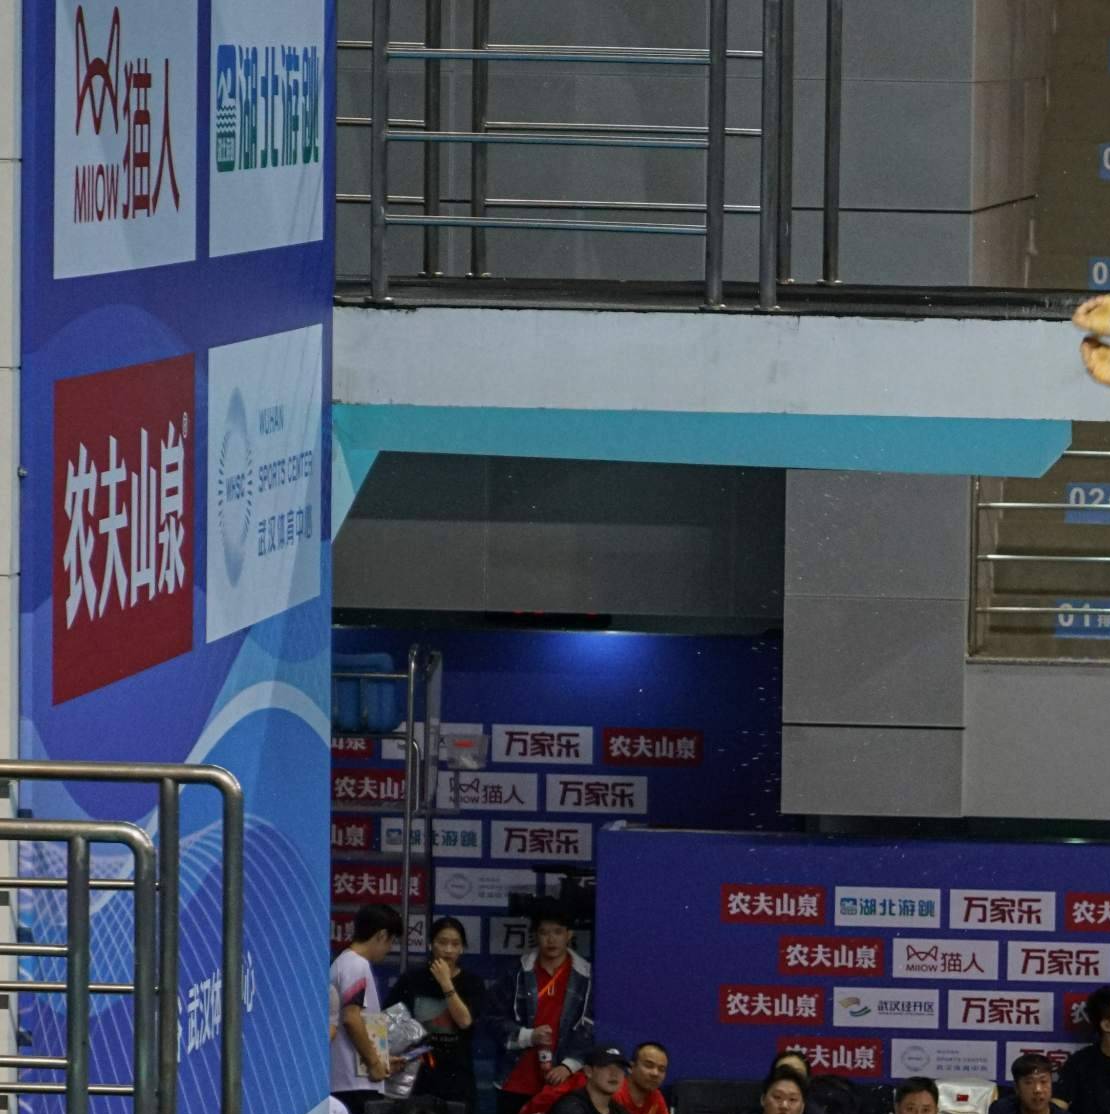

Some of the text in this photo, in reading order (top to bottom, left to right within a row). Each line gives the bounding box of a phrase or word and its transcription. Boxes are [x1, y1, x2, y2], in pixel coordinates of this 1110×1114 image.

[123, 57, 180, 220] 猫人
[63, 420, 186, 630] 农夫山泉
[504, 731, 580, 758] 万家乐
[609, 736, 696, 759] 农夫山泉
[335, 777, 405, 799] 农夫山
[482, 784, 525, 804] 猫人
[559, 781, 634, 808] 万家乐
[504, 828, 579, 855] 万家乐
[728, 892, 819, 918] 农夫山泉
[859, 898, 935, 918] 湖北游跳
[963, 896, 1042, 924] 万家乐
[785, 943, 877, 969] 农夫山泉
[941, 951, 985, 973] 猫人
[1020, 948, 1100, 977] 万家乐
[187, 951, 256, 1056] 武汉体心
[726, 993, 818, 1018] 农夫山泉
[877, 1000, 934, 1014] 武汉经开区
[961, 997, 1041, 1025] 万家乐
